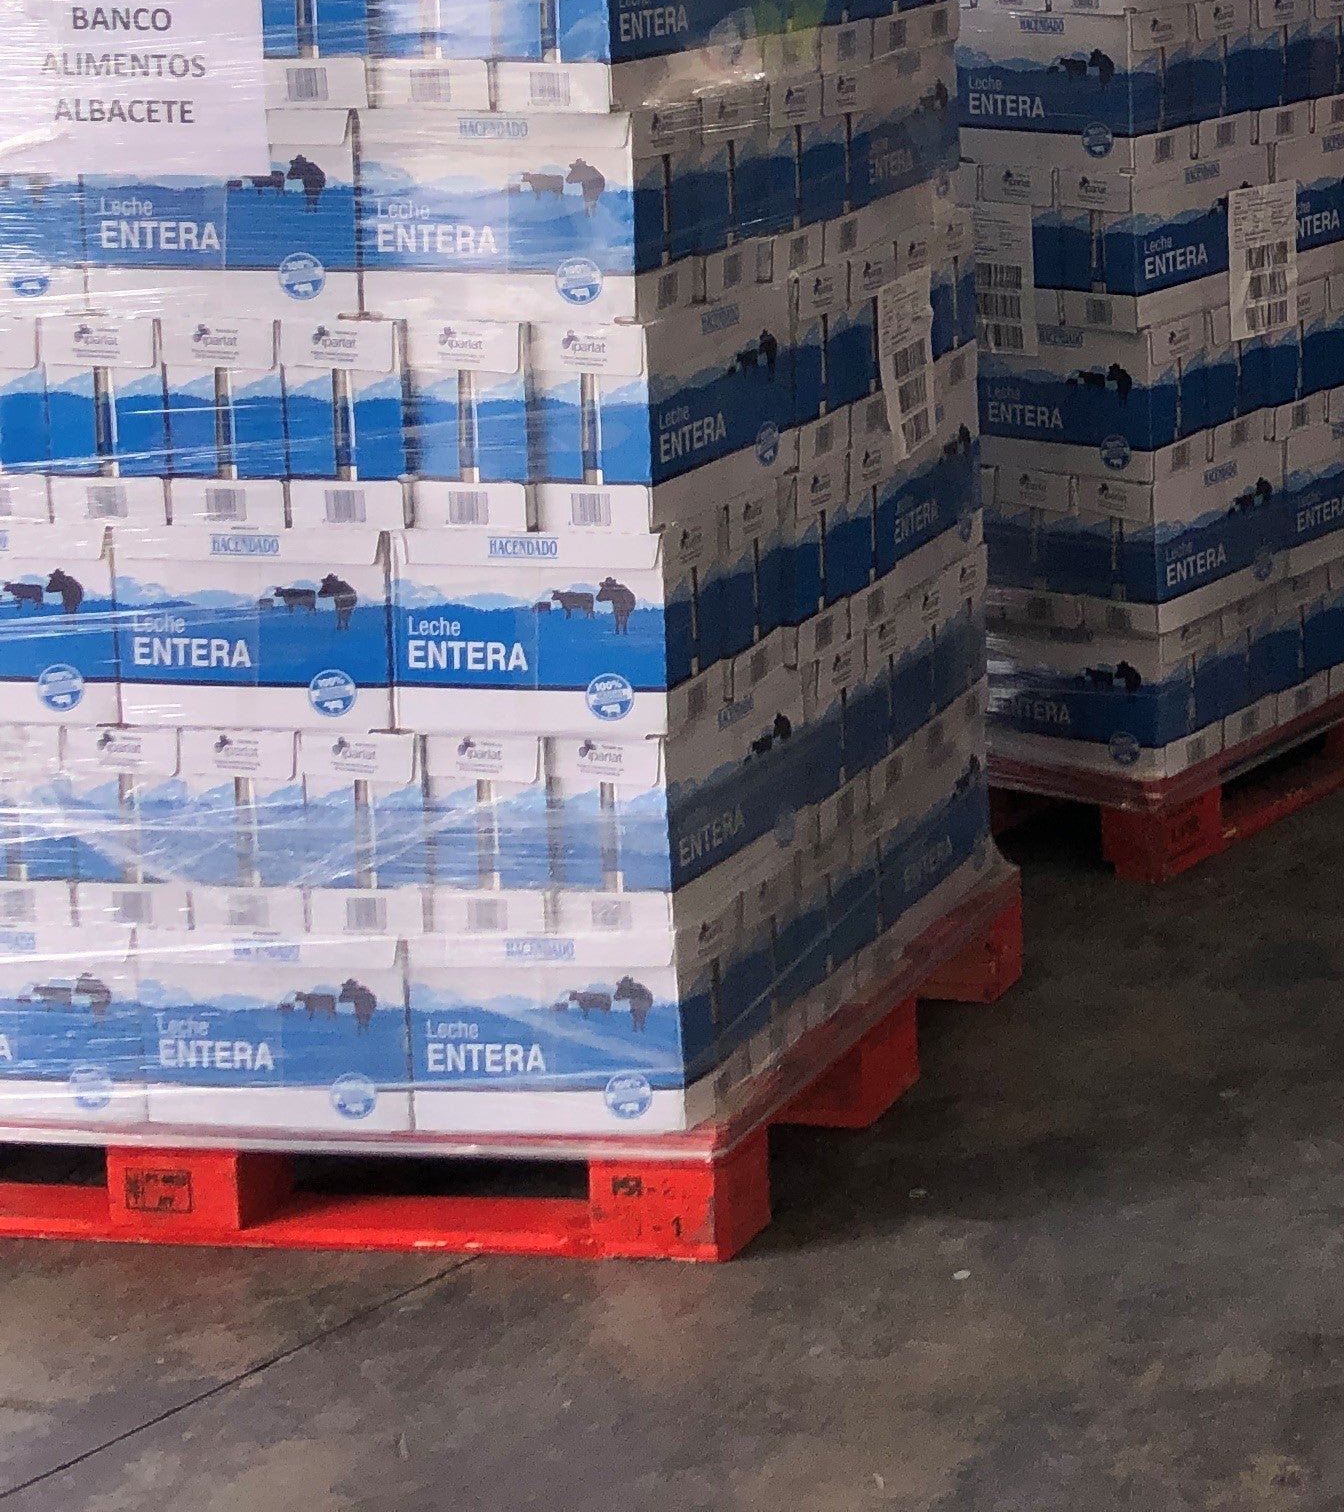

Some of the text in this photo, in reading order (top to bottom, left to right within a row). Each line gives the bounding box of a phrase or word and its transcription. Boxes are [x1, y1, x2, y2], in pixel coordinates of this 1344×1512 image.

[71, 7, 172, 31] BANCO
[619, 6, 689, 43] ENTERA
[1019, 17, 1065, 34] HACENDADO
[41, 53, 206, 78] ALIMENTOS
[54, 100, 196, 124] ALBACETE
[969, 93, 1045, 119] ENTERA
[377, 197, 430, 220] Leche
[101, 220, 221, 251] ENTERA
[377, 223, 499, 255] ENTERA
[1297, 210, 1341, 240] NTERA
[1145, 235, 1172, 253] Leche
[1145, 244, 1208, 279] ENTERA
[988, 402, 1064, 430] ENTERA
[659, 412, 727, 464] ENTERA
[210, 536, 280, 555] HACENDADO
[488, 538, 559, 558] HACENDADO
[1166, 545, 1227, 587] ENTERA
[408, 617, 461, 637] Leche
[134, 639, 252, 668] ENTERA
[408, 641, 529, 672] ENTERA
[678, 810, 745, 866] ENTERA
[159, 1039, 275, 1070] ENTERA
[427, 1044, 547, 1073] ENTERA
